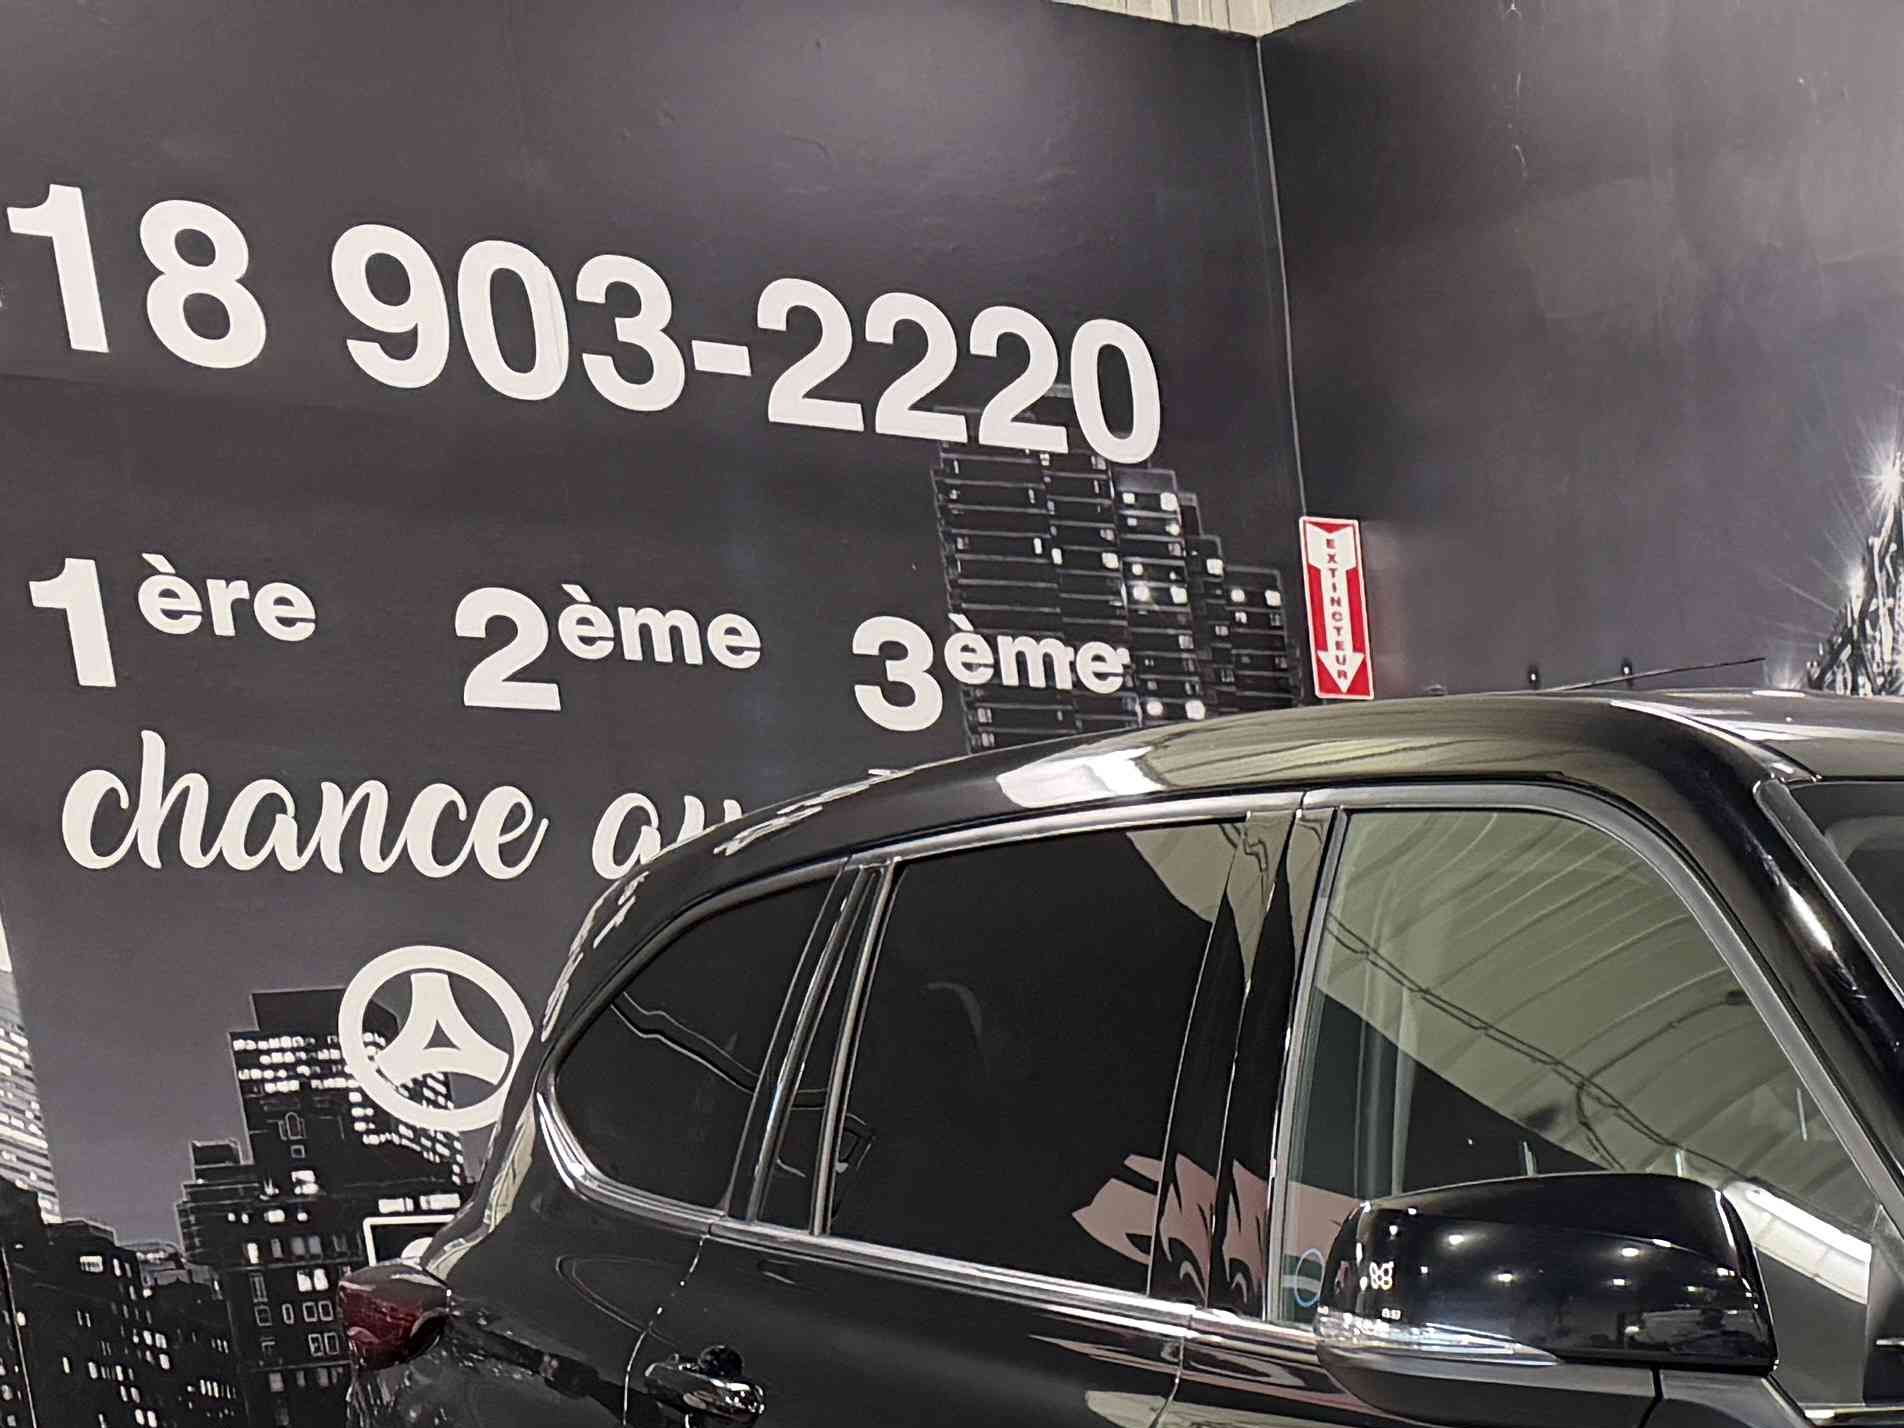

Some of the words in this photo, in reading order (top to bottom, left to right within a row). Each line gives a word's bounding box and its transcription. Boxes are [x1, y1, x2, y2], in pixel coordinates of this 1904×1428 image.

[0, 184, 268, 369] 18
[332, 225, 1161, 464] 903-2220
[28, 552, 317, 688] 1ère
[454, 583, 762, 711] 2ème
[852, 611, 1131, 732] 3ème
[1326, 538, 1348, 680] EXTINCTEUR
[61, 729, 548, 880] chance
